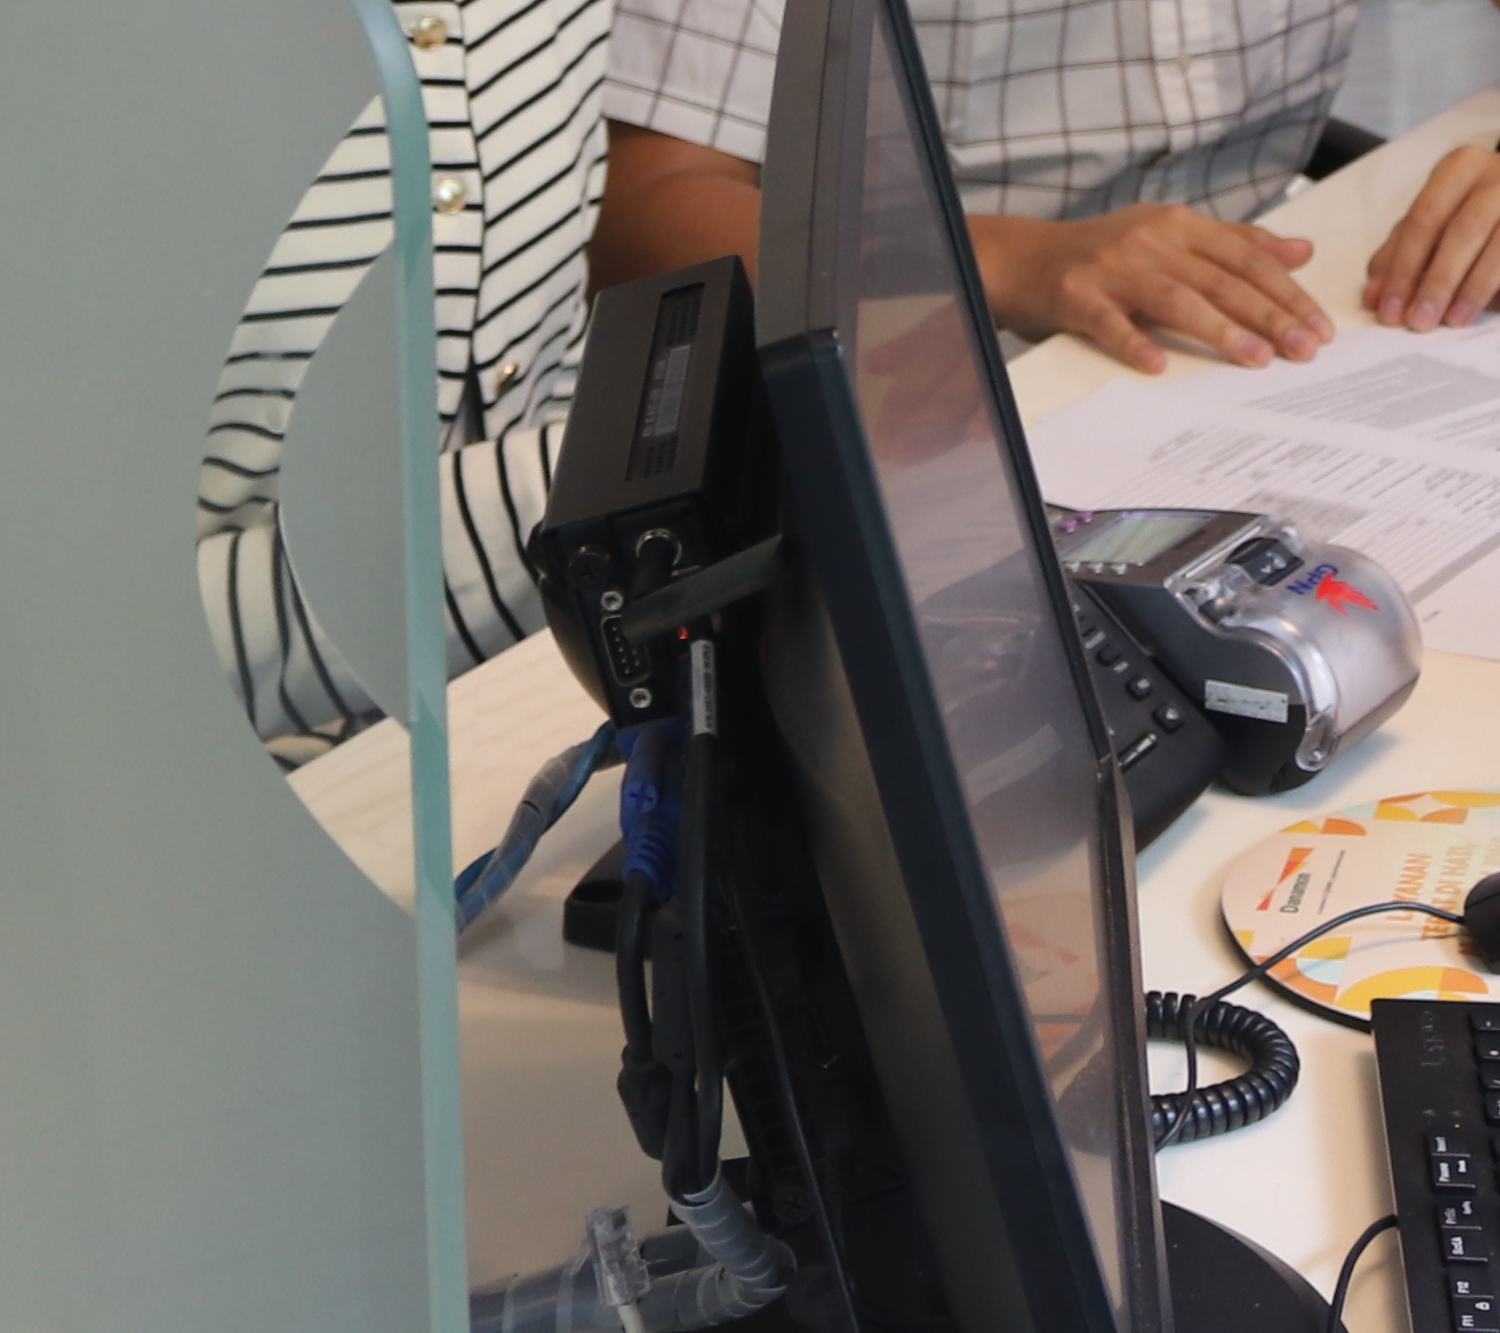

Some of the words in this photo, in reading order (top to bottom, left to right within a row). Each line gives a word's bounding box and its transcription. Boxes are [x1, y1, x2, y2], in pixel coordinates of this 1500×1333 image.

[1279, 872, 1312, 914] Danamon
[1386, 853, 1433, 922] LYANAN
[1438, 1162, 1451, 1183] Pause
